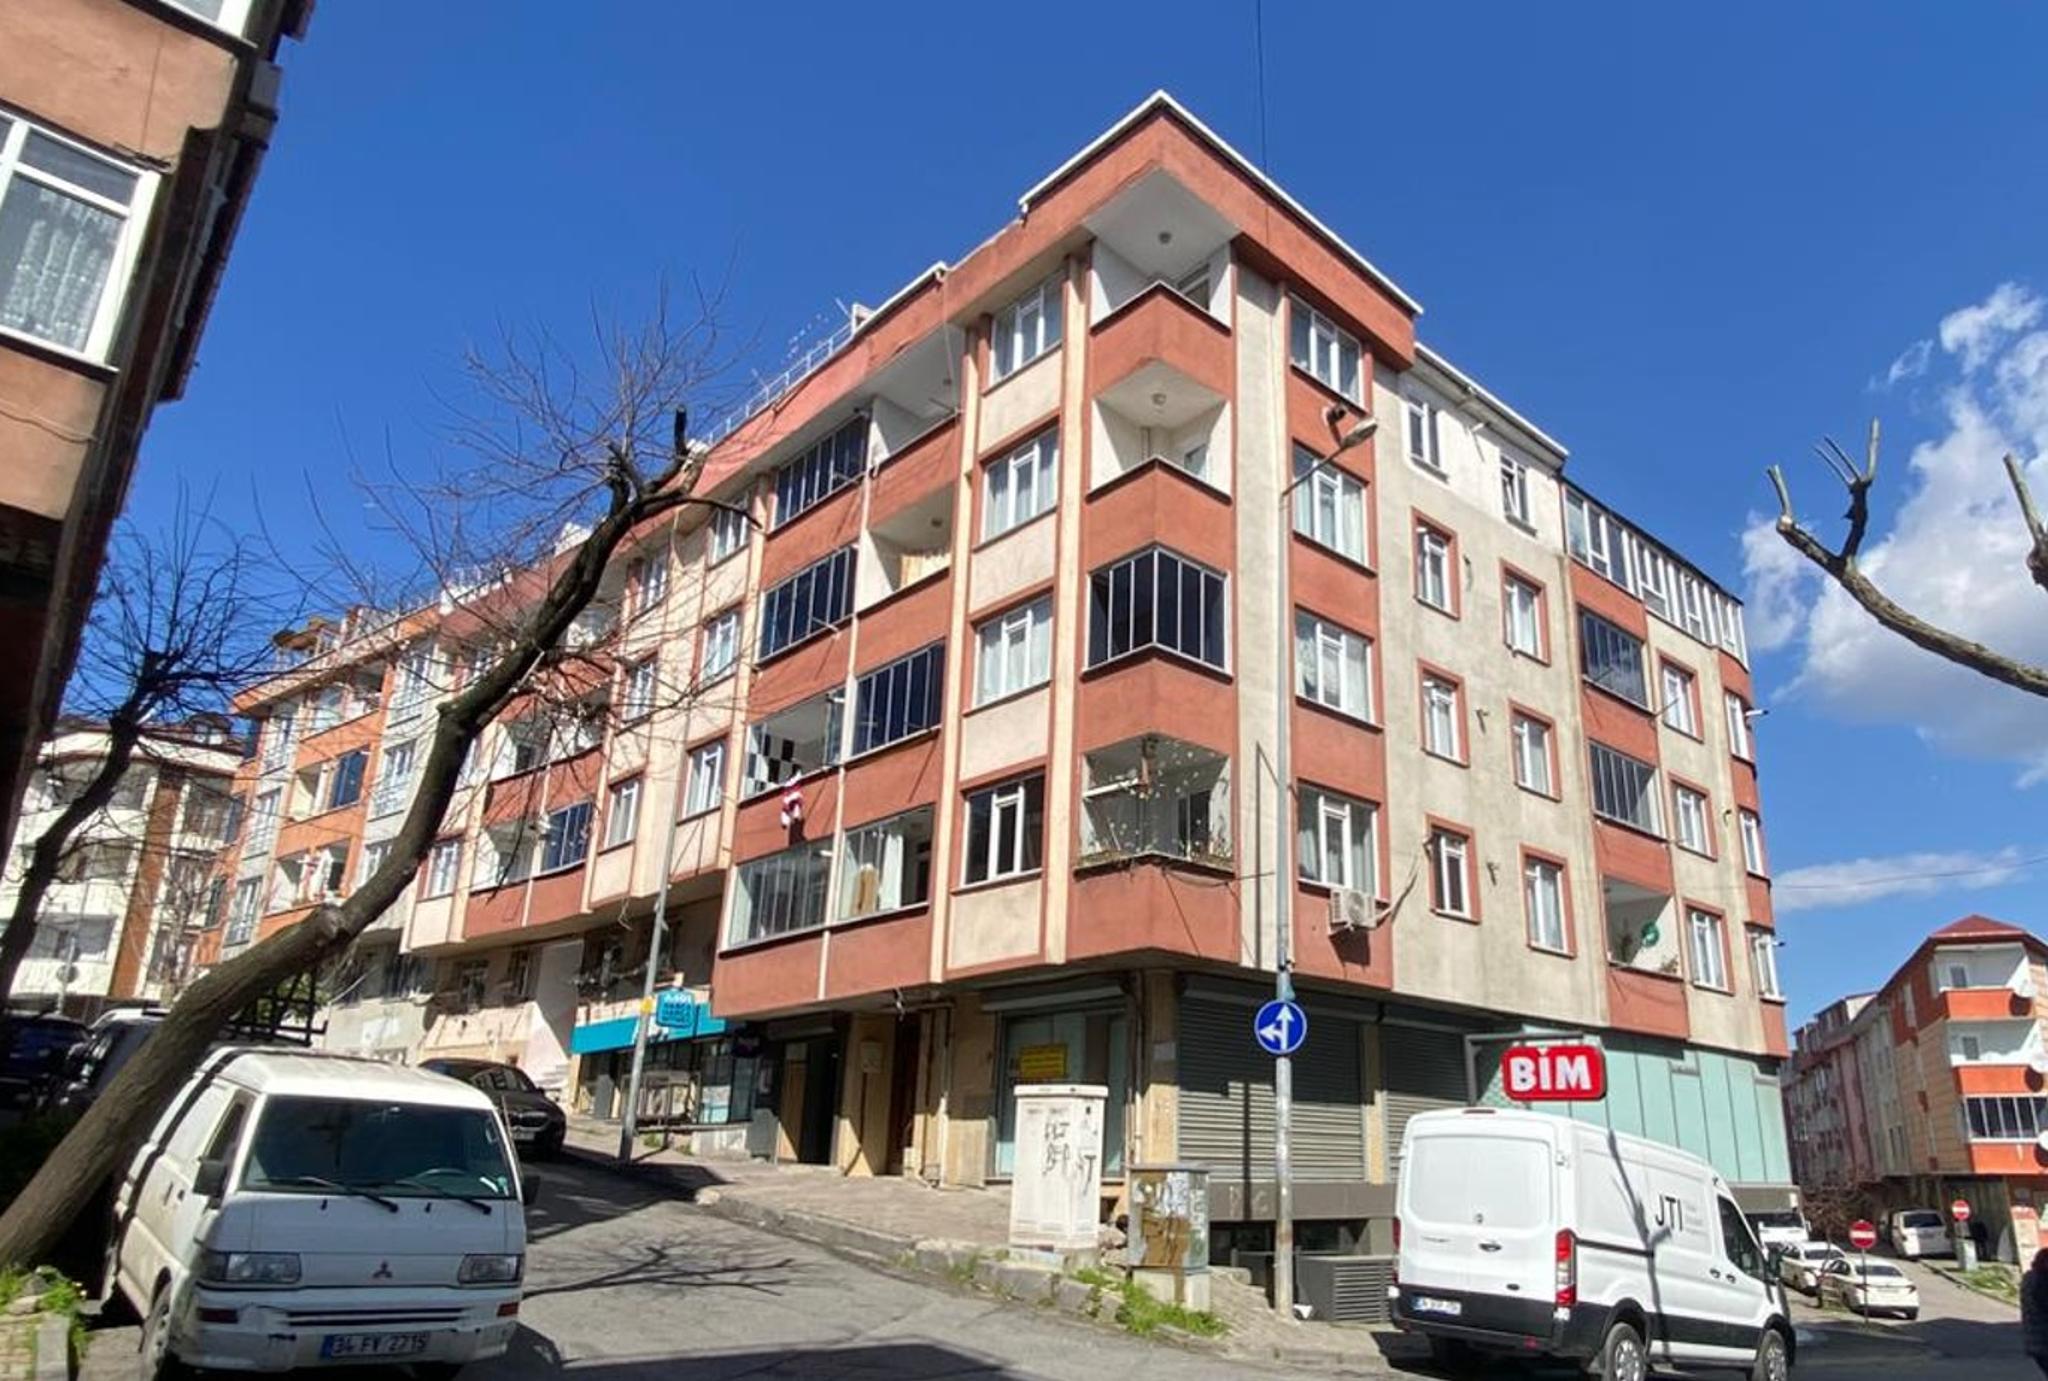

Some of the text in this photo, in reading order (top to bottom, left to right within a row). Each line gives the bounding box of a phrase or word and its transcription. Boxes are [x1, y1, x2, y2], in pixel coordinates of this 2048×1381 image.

[1510, 1048, 1592, 1091] BİM
[1655, 1194, 1683, 1232] JTI
[334, 1335, 354, 1353] 34
